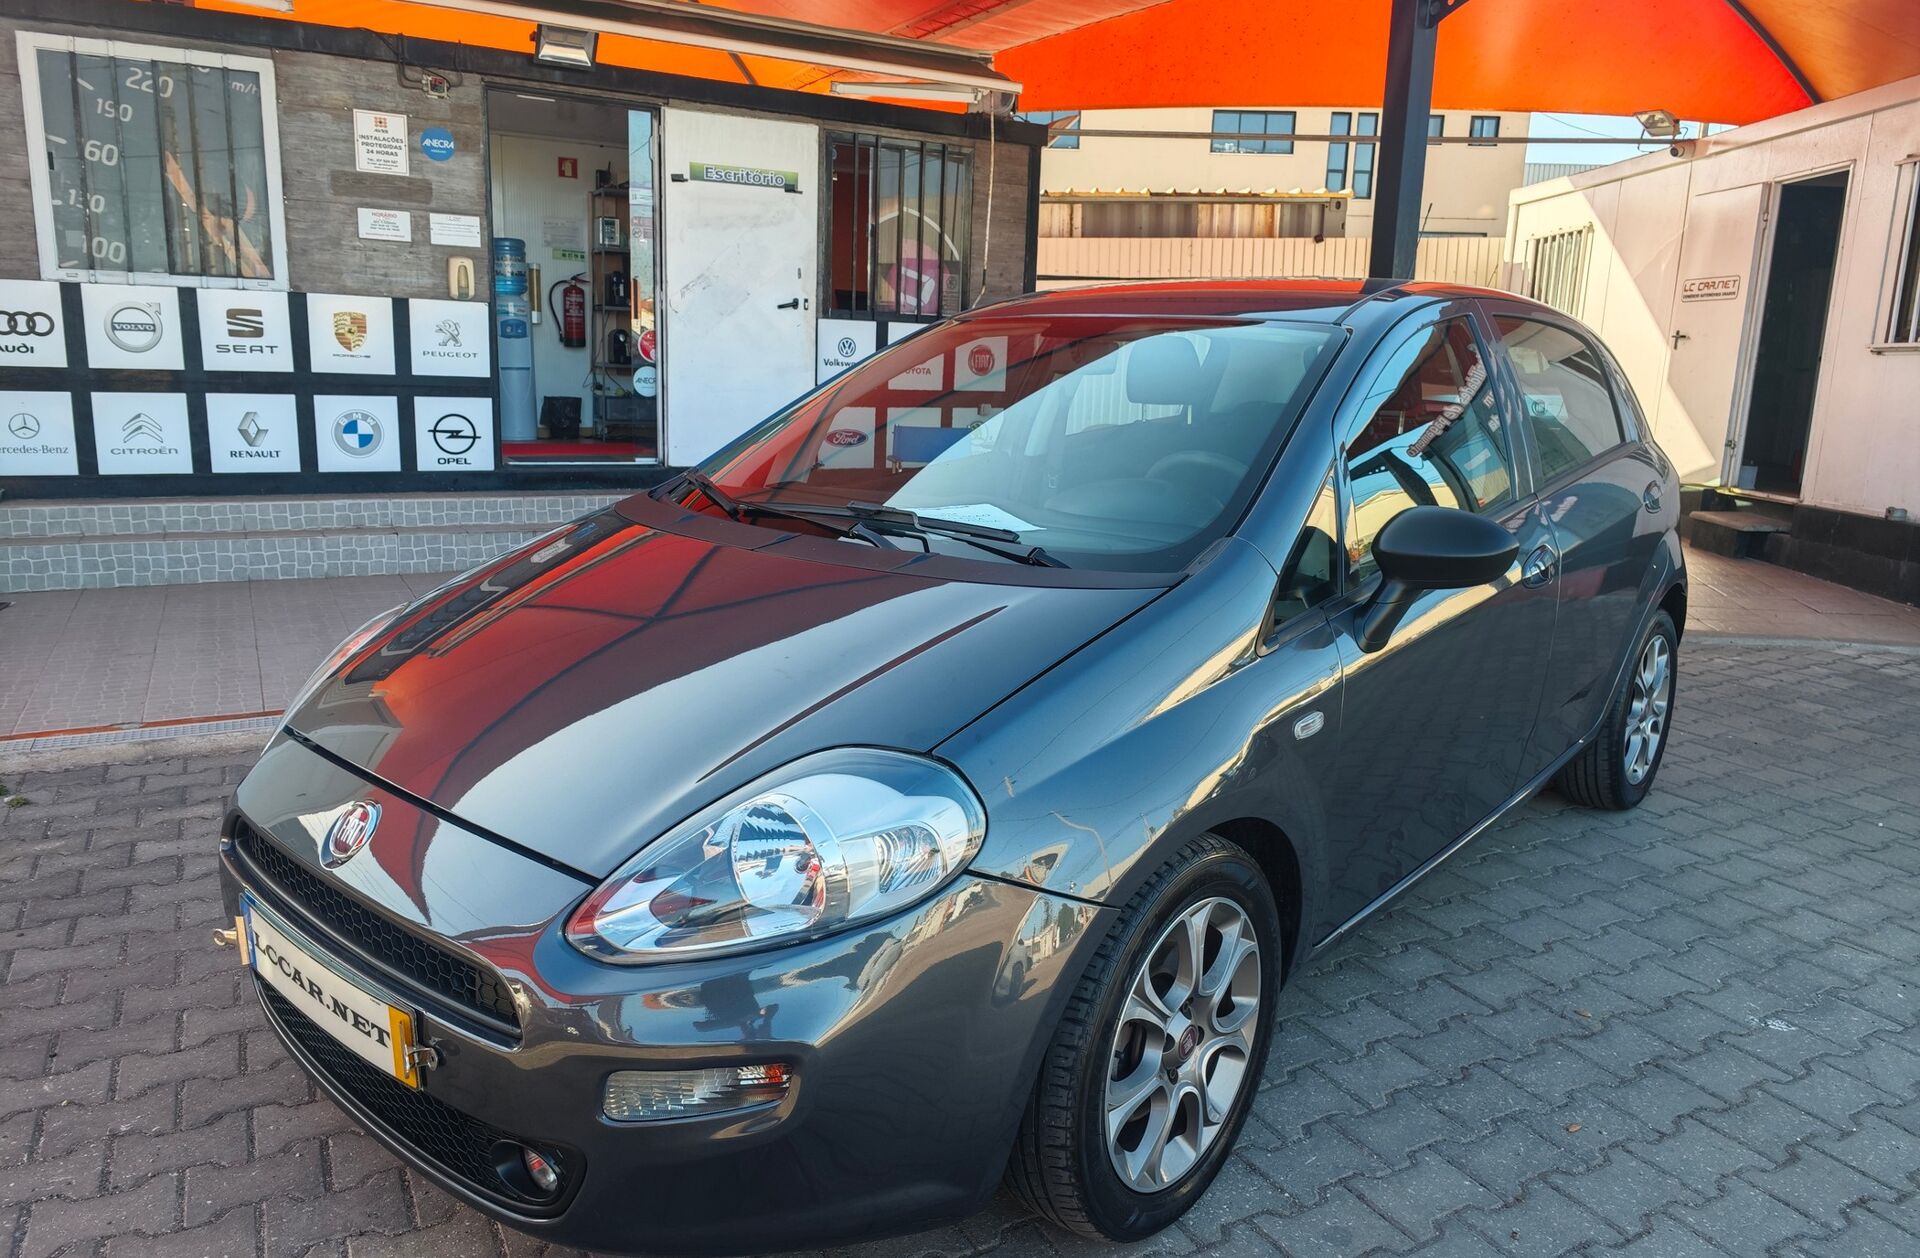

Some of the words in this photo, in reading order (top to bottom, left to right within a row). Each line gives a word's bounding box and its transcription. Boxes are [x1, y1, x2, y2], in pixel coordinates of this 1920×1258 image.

[125, 67, 174, 98] 220
[361, 141, 402, 151] PROTEGIDAS
[422, 138, 454, 149] ANECRA
[80, 139, 119, 166] 60
[376, 149, 398, 157] HORAS
[704, 164, 785, 187] Escritório
[1683, 283, 1696, 292] LC
[113, 323, 154, 331] VOLVO
[215, 344, 279, 354] SEAT
[423, 351, 479, 359] PEUGEOT
[974, 354, 990, 369] FIAT
[905, 367, 932, 376] OYOTA
[338, 412, 377, 427] BMW
[832, 431, 860, 445] Ford
[0, 444, 69, 454] rcedes-Benz
[110, 446, 178, 455] CITROËN
[229, 450, 281, 458] RENAULT
[437, 457, 472, 465] OPEL
[337, 816, 366, 846] FIAT
[254, 930, 391, 1049] LCCAR.NET
